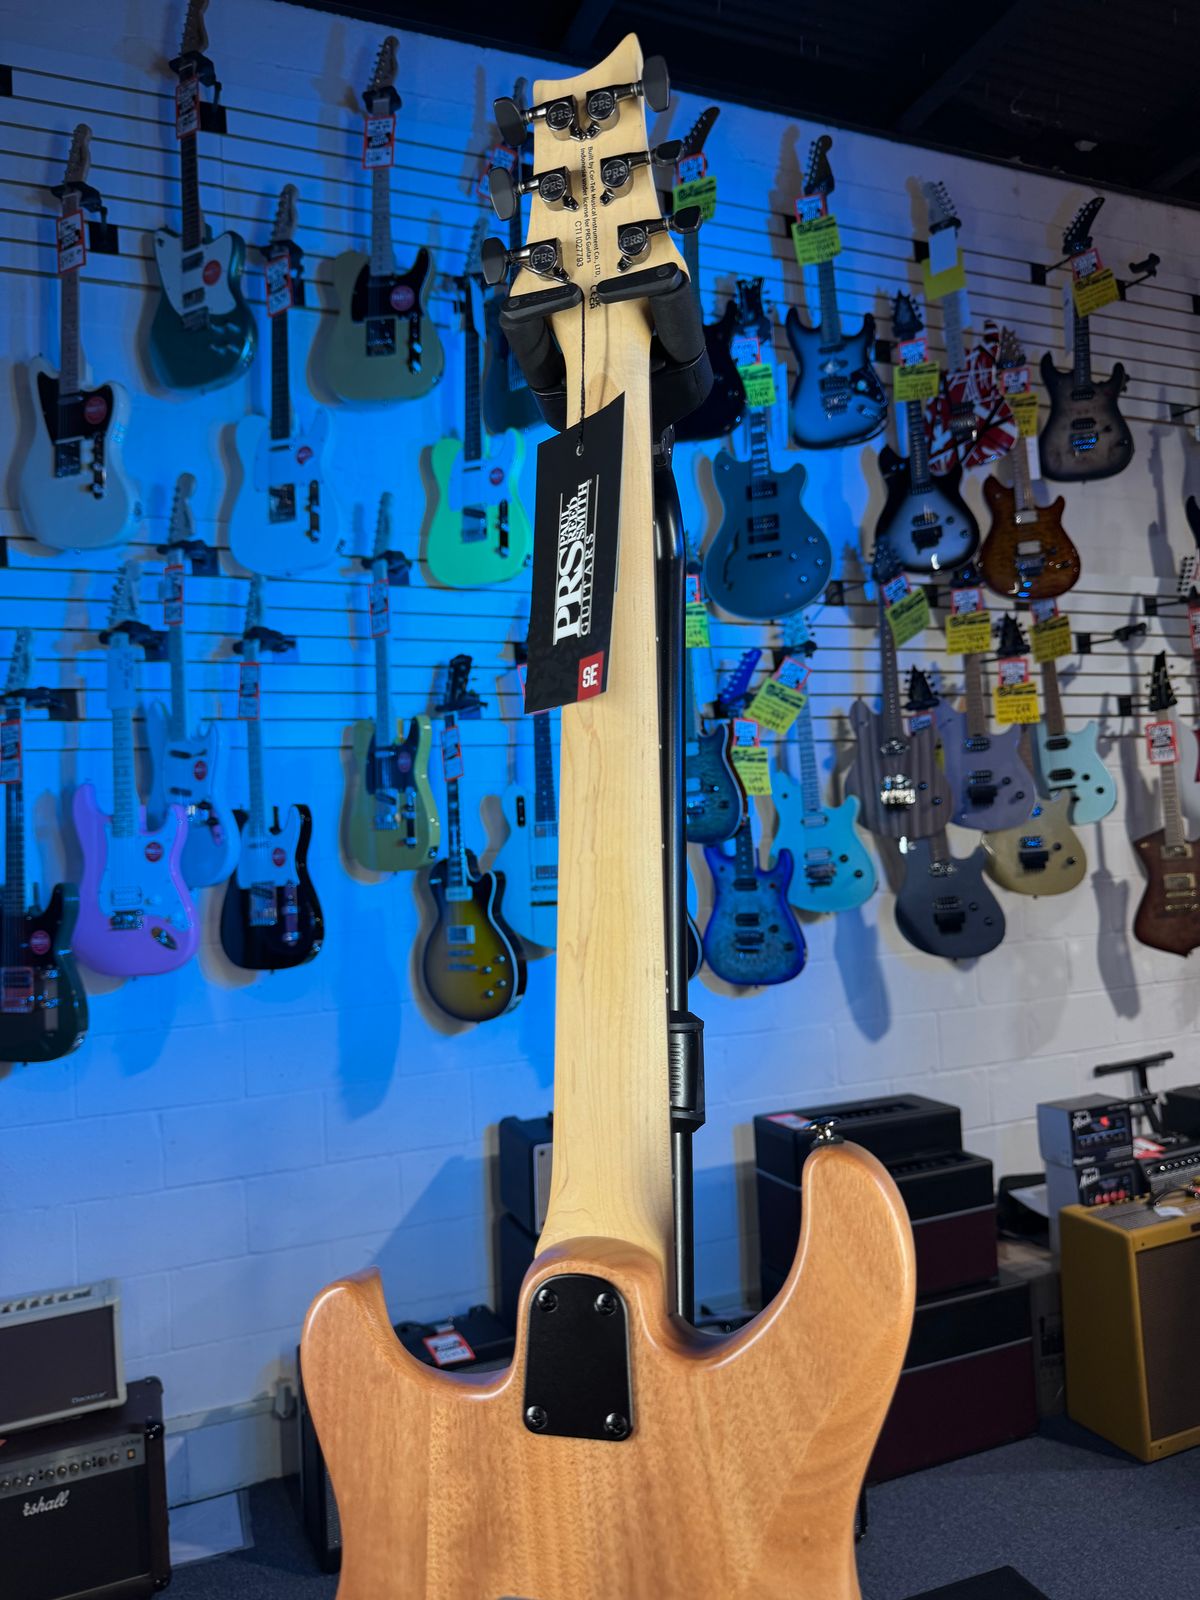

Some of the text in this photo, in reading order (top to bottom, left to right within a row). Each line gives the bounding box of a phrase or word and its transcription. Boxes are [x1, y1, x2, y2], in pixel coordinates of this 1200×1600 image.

[550, 108, 572, 122] PRS
[590, 98, 612, 112] PRS
[605, 166, 626, 181] PRS
[543, 180, 564, 194] PRS
[622, 233, 643, 247] PRS
[534, 251, 555, 264] PRS
[567, 496, 578, 543] REED
[576, 480, 589, 539] SMITH
[560, 504, 570, 547] PAUL
[555, 540, 584, 641] PRS
[581, 533, 594, 636] GUITARS
[582, 663, 599, 688] SE
